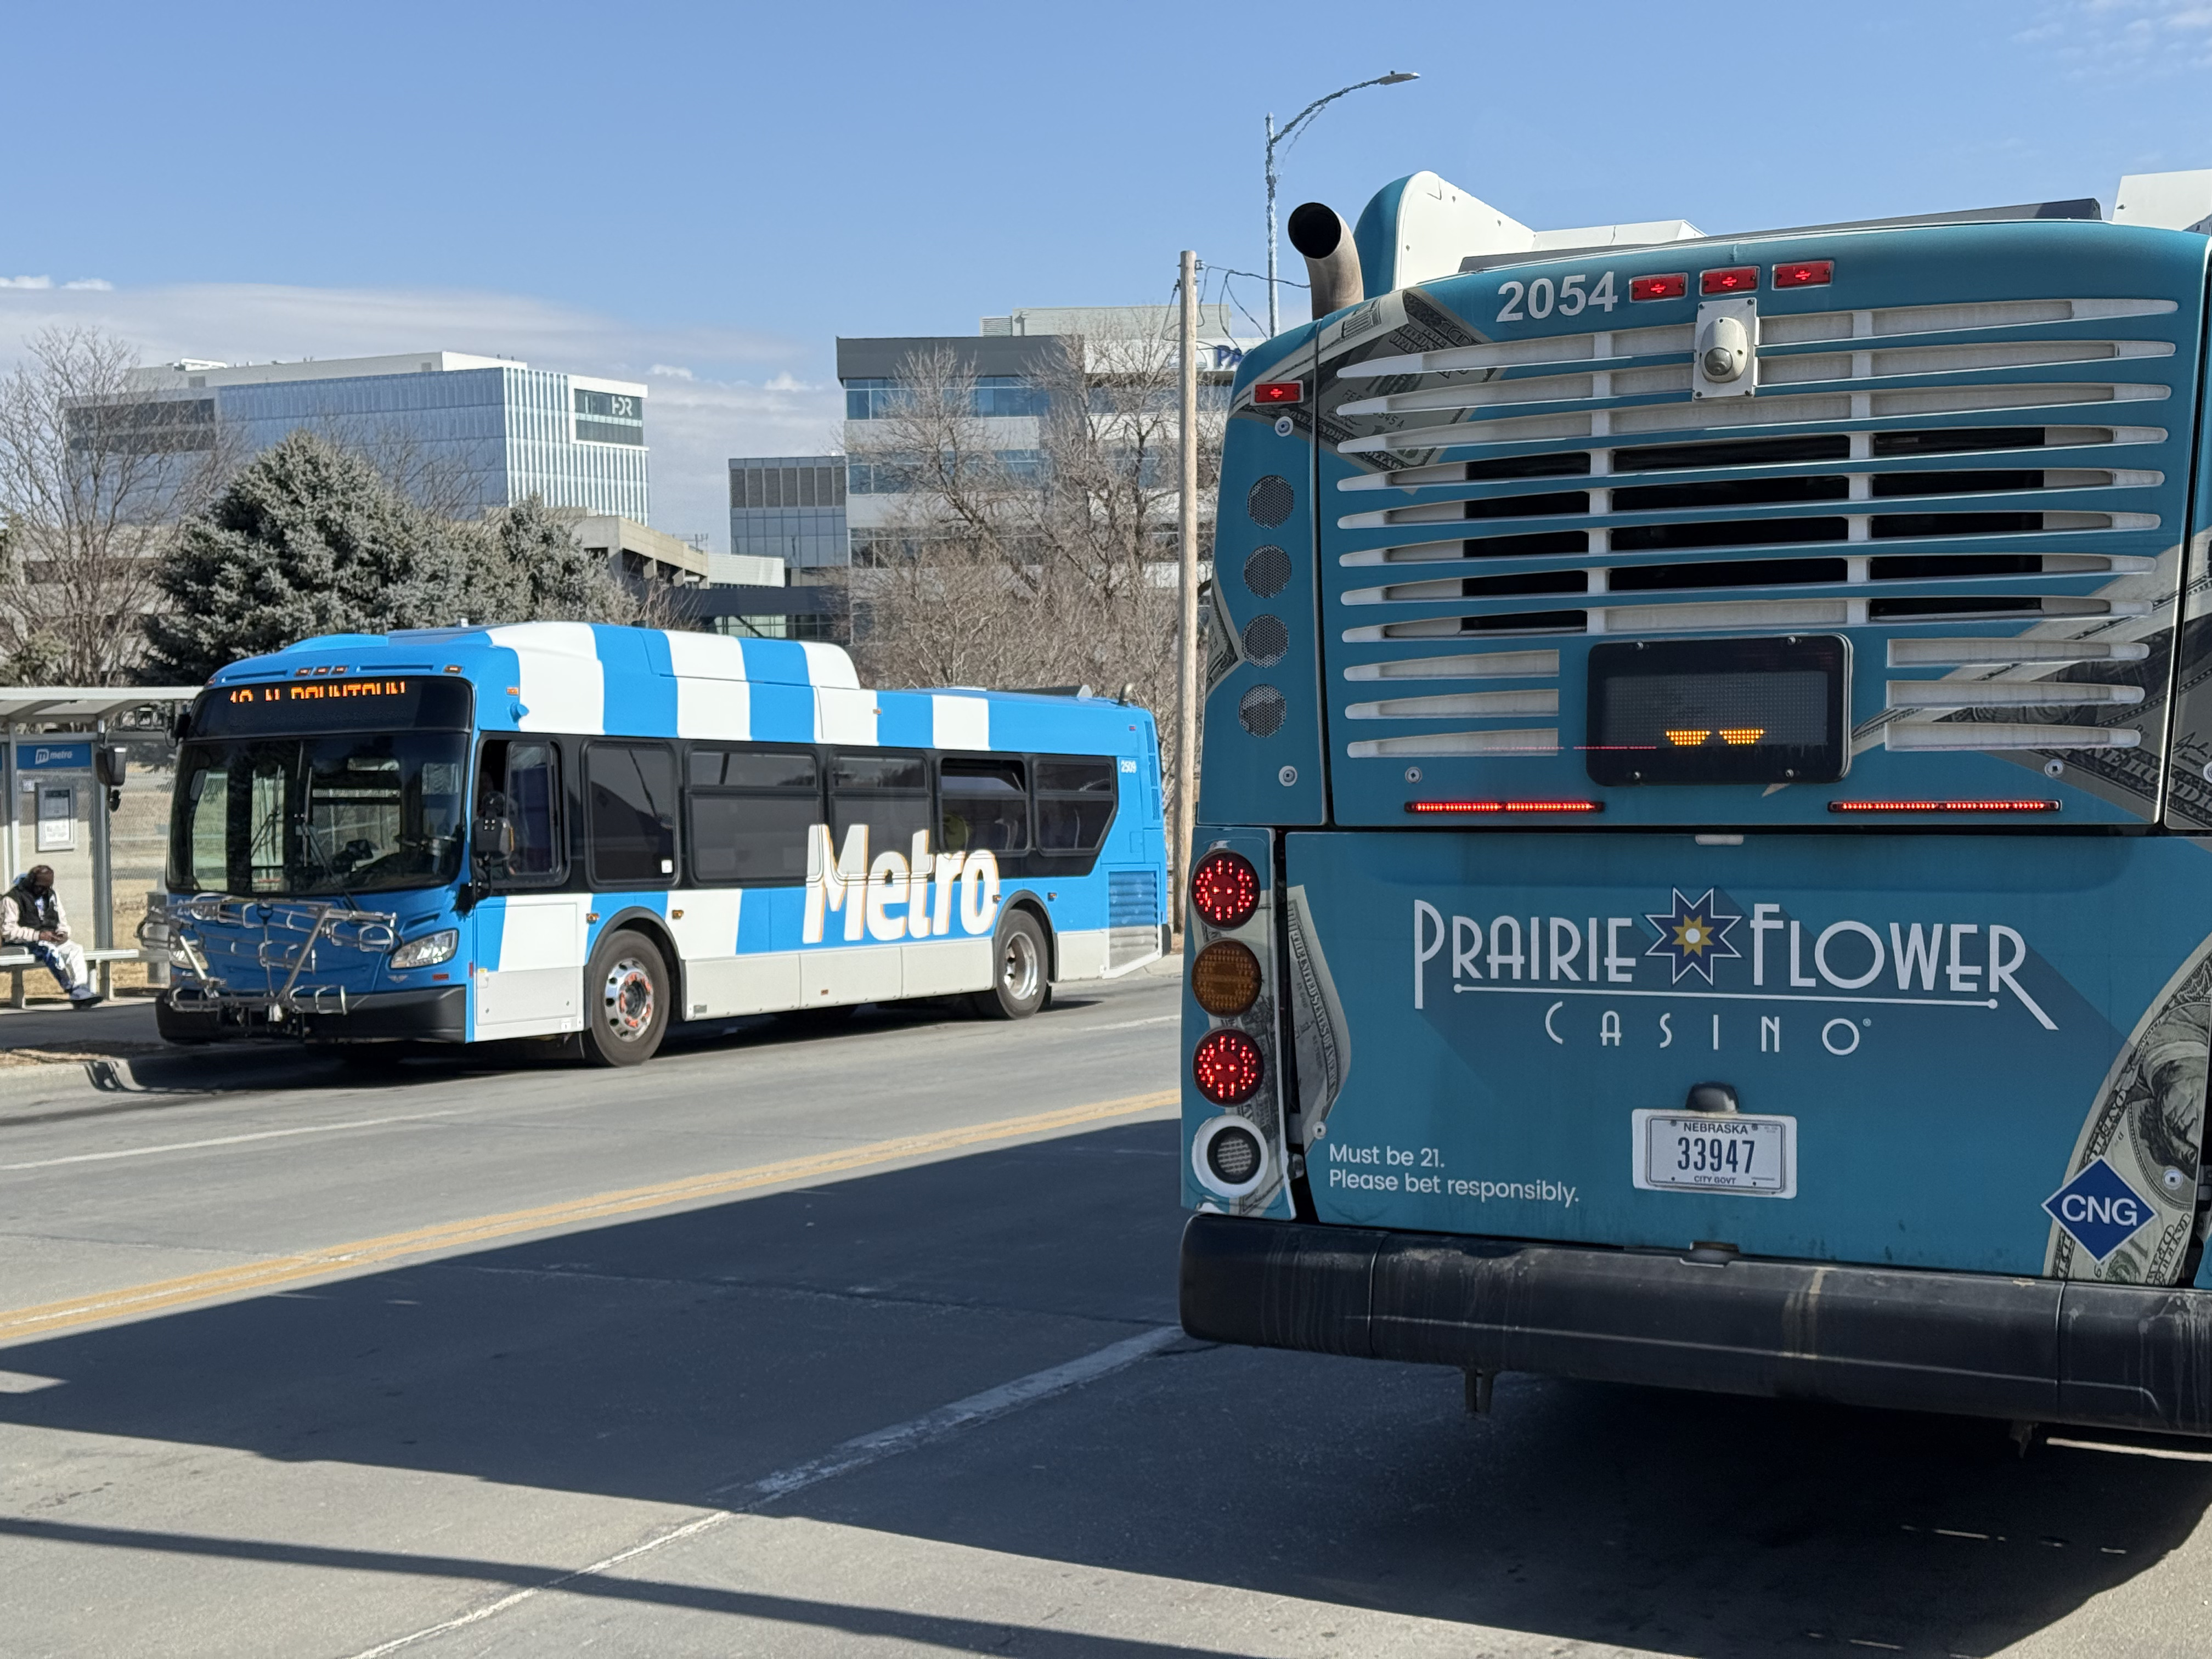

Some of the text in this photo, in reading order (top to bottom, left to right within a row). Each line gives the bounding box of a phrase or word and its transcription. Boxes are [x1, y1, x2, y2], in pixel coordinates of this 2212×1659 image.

[1496, 271, 1618, 323] 2054
[612, 396, 633, 416] HDR
[50, 751, 73, 760] metro
[803, 823, 1000, 944] Metro
[1414, 899, 2059, 1031] PRAIRIE FLOWER
[1545, 1001, 1860, 1056] CASINO
[1684, 1122, 1748, 1135] NEBRASKA
[1329, 1143, 1445, 1168] Must be 21.
[1677, 1137, 1755, 1174] 33947
[1329, 1169, 1579, 1208] Please bet responsibly.
[1694, 1175, 1737, 1185] CITY GOVT
[2061, 1193, 2137, 1227] CNG
